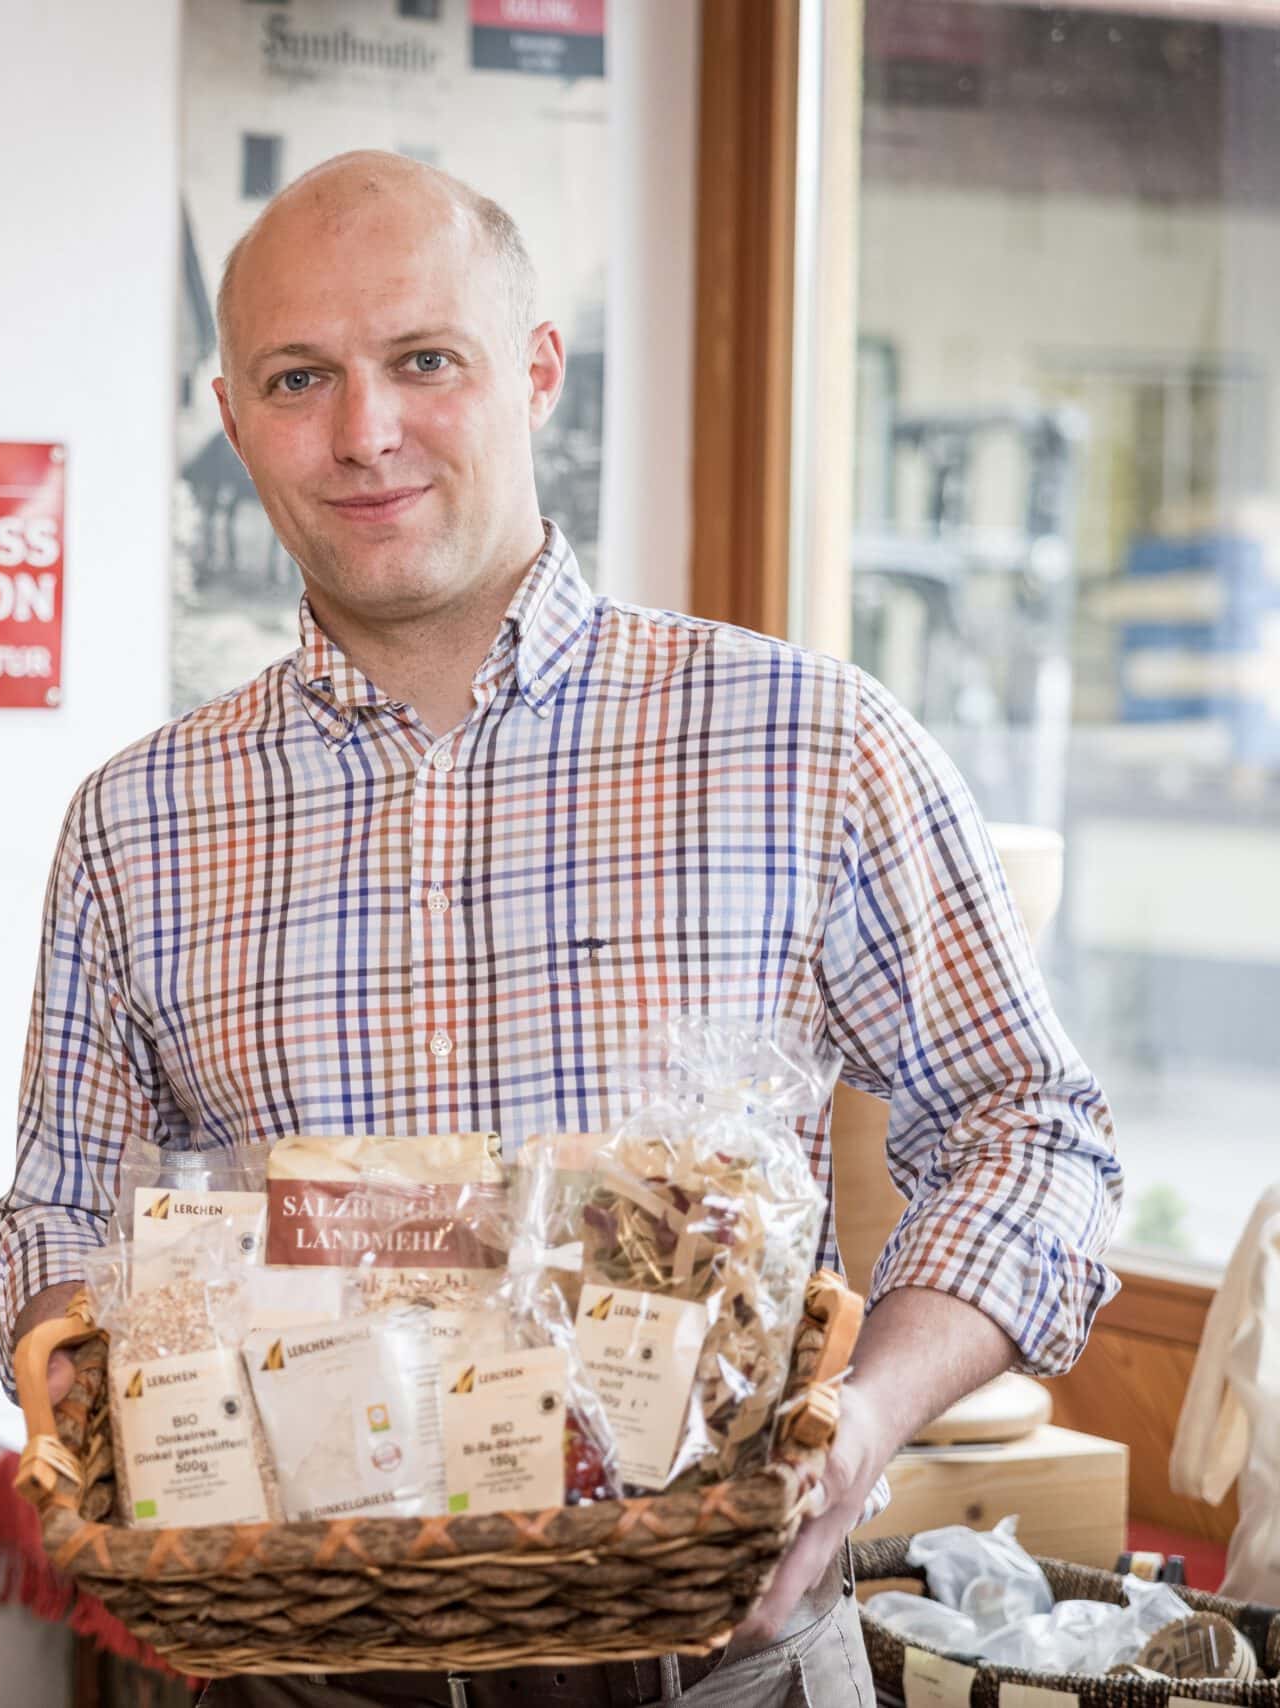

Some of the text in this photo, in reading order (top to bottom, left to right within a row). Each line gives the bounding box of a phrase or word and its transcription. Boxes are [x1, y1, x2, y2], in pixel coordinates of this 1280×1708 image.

[174, 1203, 223, 1216] LERCHEN
[296, 1227, 449, 1252] LANDMEHL
[146, 1371, 198, 1388] LERCHEN
[478, 1367, 524, 1384] LERCHEN
[172, 1413, 198, 1428] BIO
[491, 1421, 514, 1436] BIO
[175, 1459, 209, 1474] 500g
